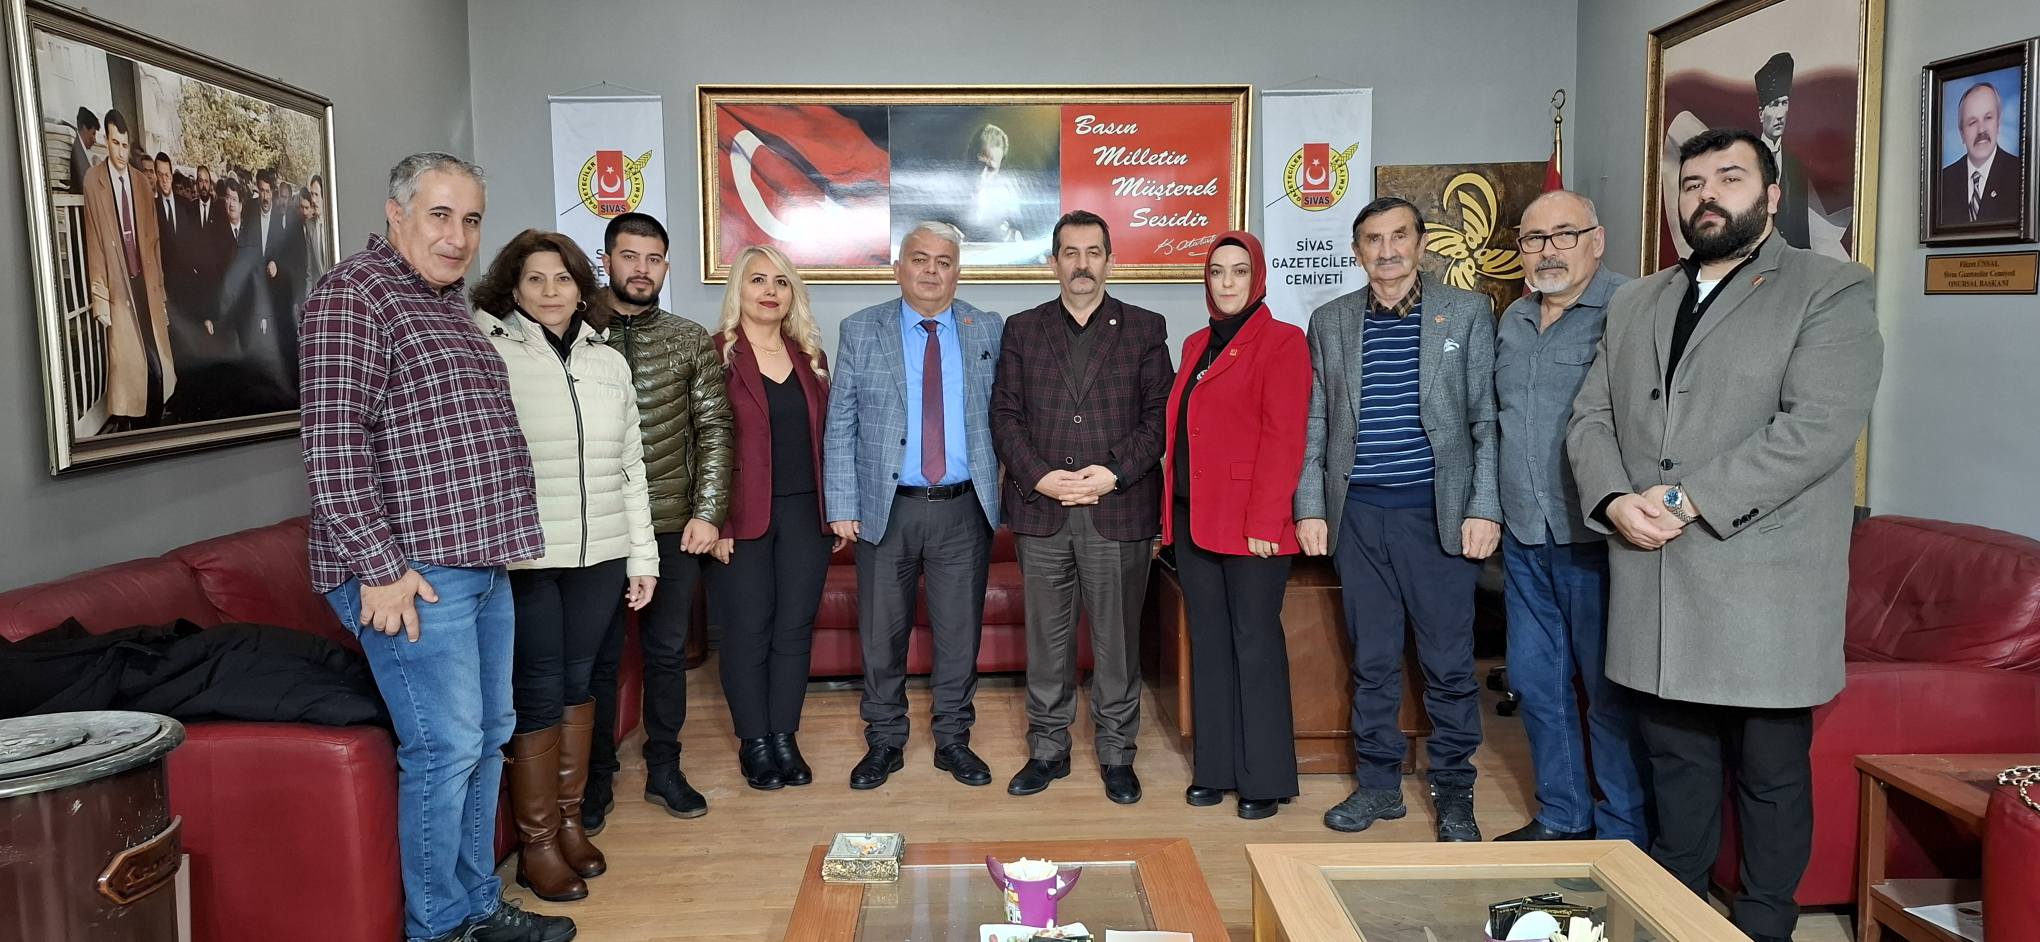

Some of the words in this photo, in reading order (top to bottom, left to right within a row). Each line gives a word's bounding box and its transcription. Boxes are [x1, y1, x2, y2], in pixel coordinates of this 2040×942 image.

[1074, 114, 1139, 135] Basın
[1093, 145, 1189, 166] Milletin
[1111, 176, 1219, 200] Müşterek
[1130, 207, 1209, 228] Sesidir
[1296, 237, 1334, 252] SİVAS
[1272, 254, 1357, 268] GAZETECİLER
[1285, 270, 1343, 285] CEMİYETİ
